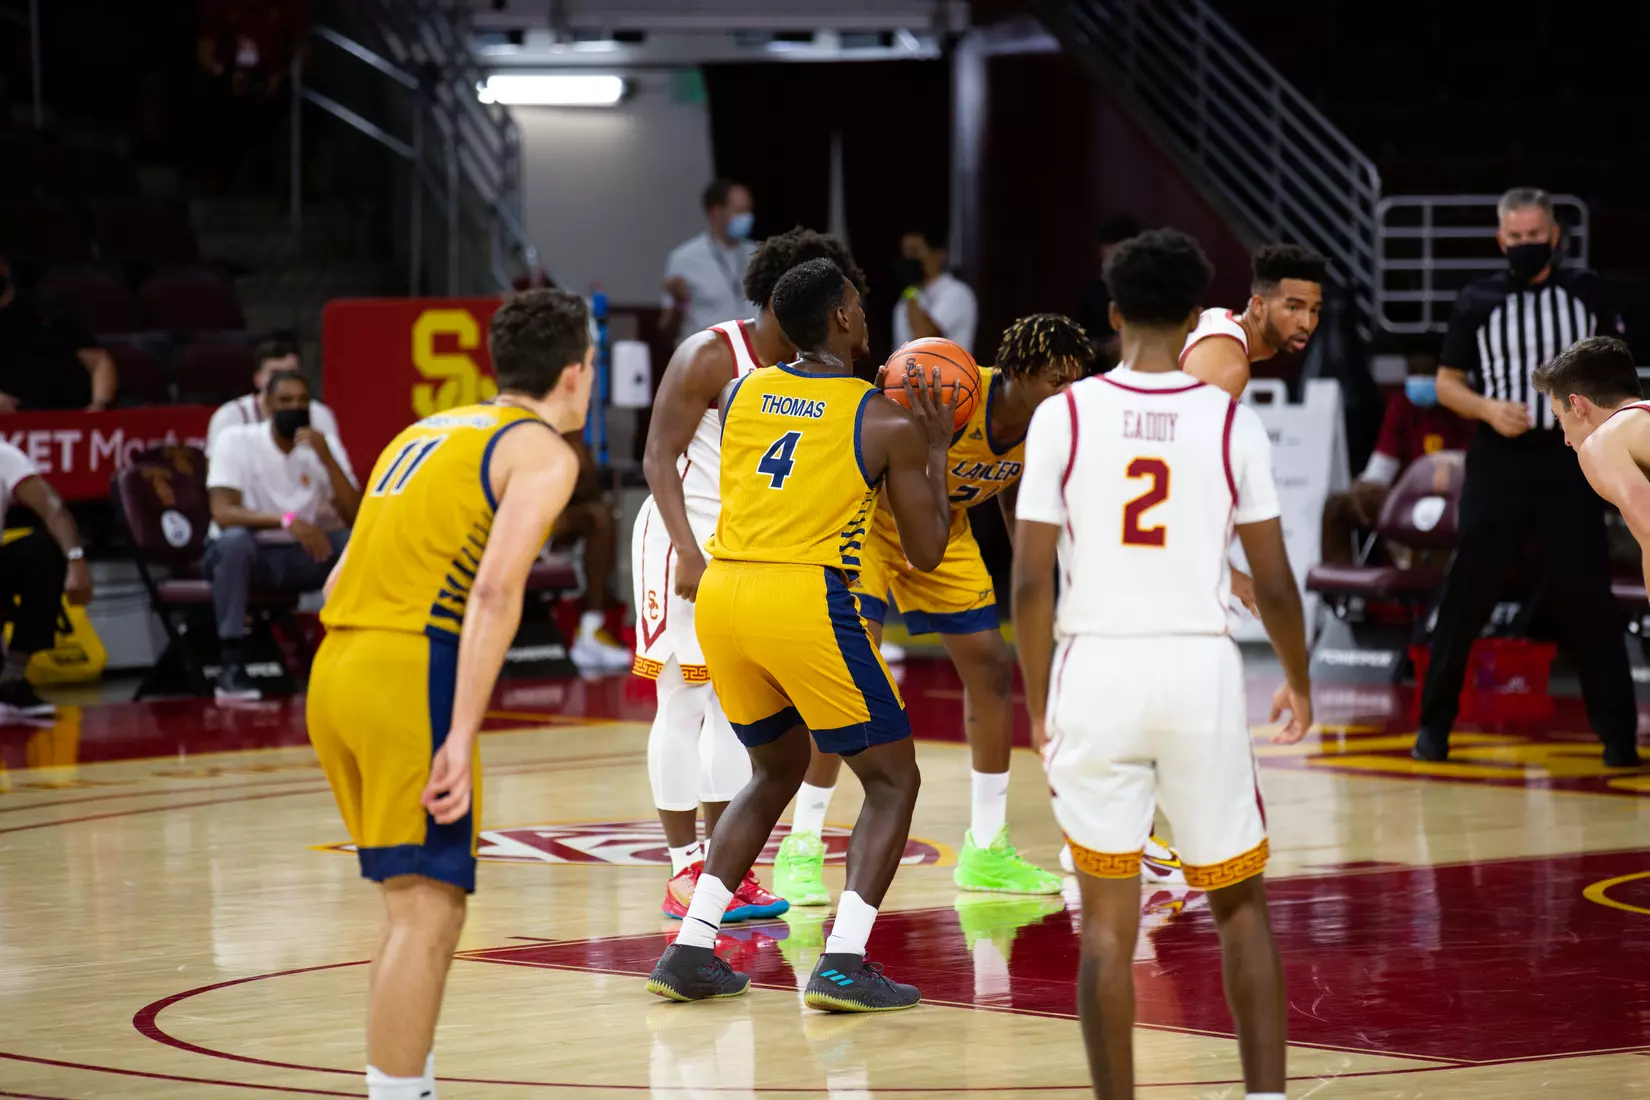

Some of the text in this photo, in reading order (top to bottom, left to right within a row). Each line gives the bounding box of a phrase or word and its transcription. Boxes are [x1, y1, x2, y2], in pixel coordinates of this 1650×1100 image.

[411, 307, 499, 419] S
[760, 392, 826, 419] THOMAS
[1122, 409, 1179, 443] EADDY
[370, 432, 450, 498] 11
[755, 430, 804, 490] 4
[1121, 455, 1172, 549] 2
